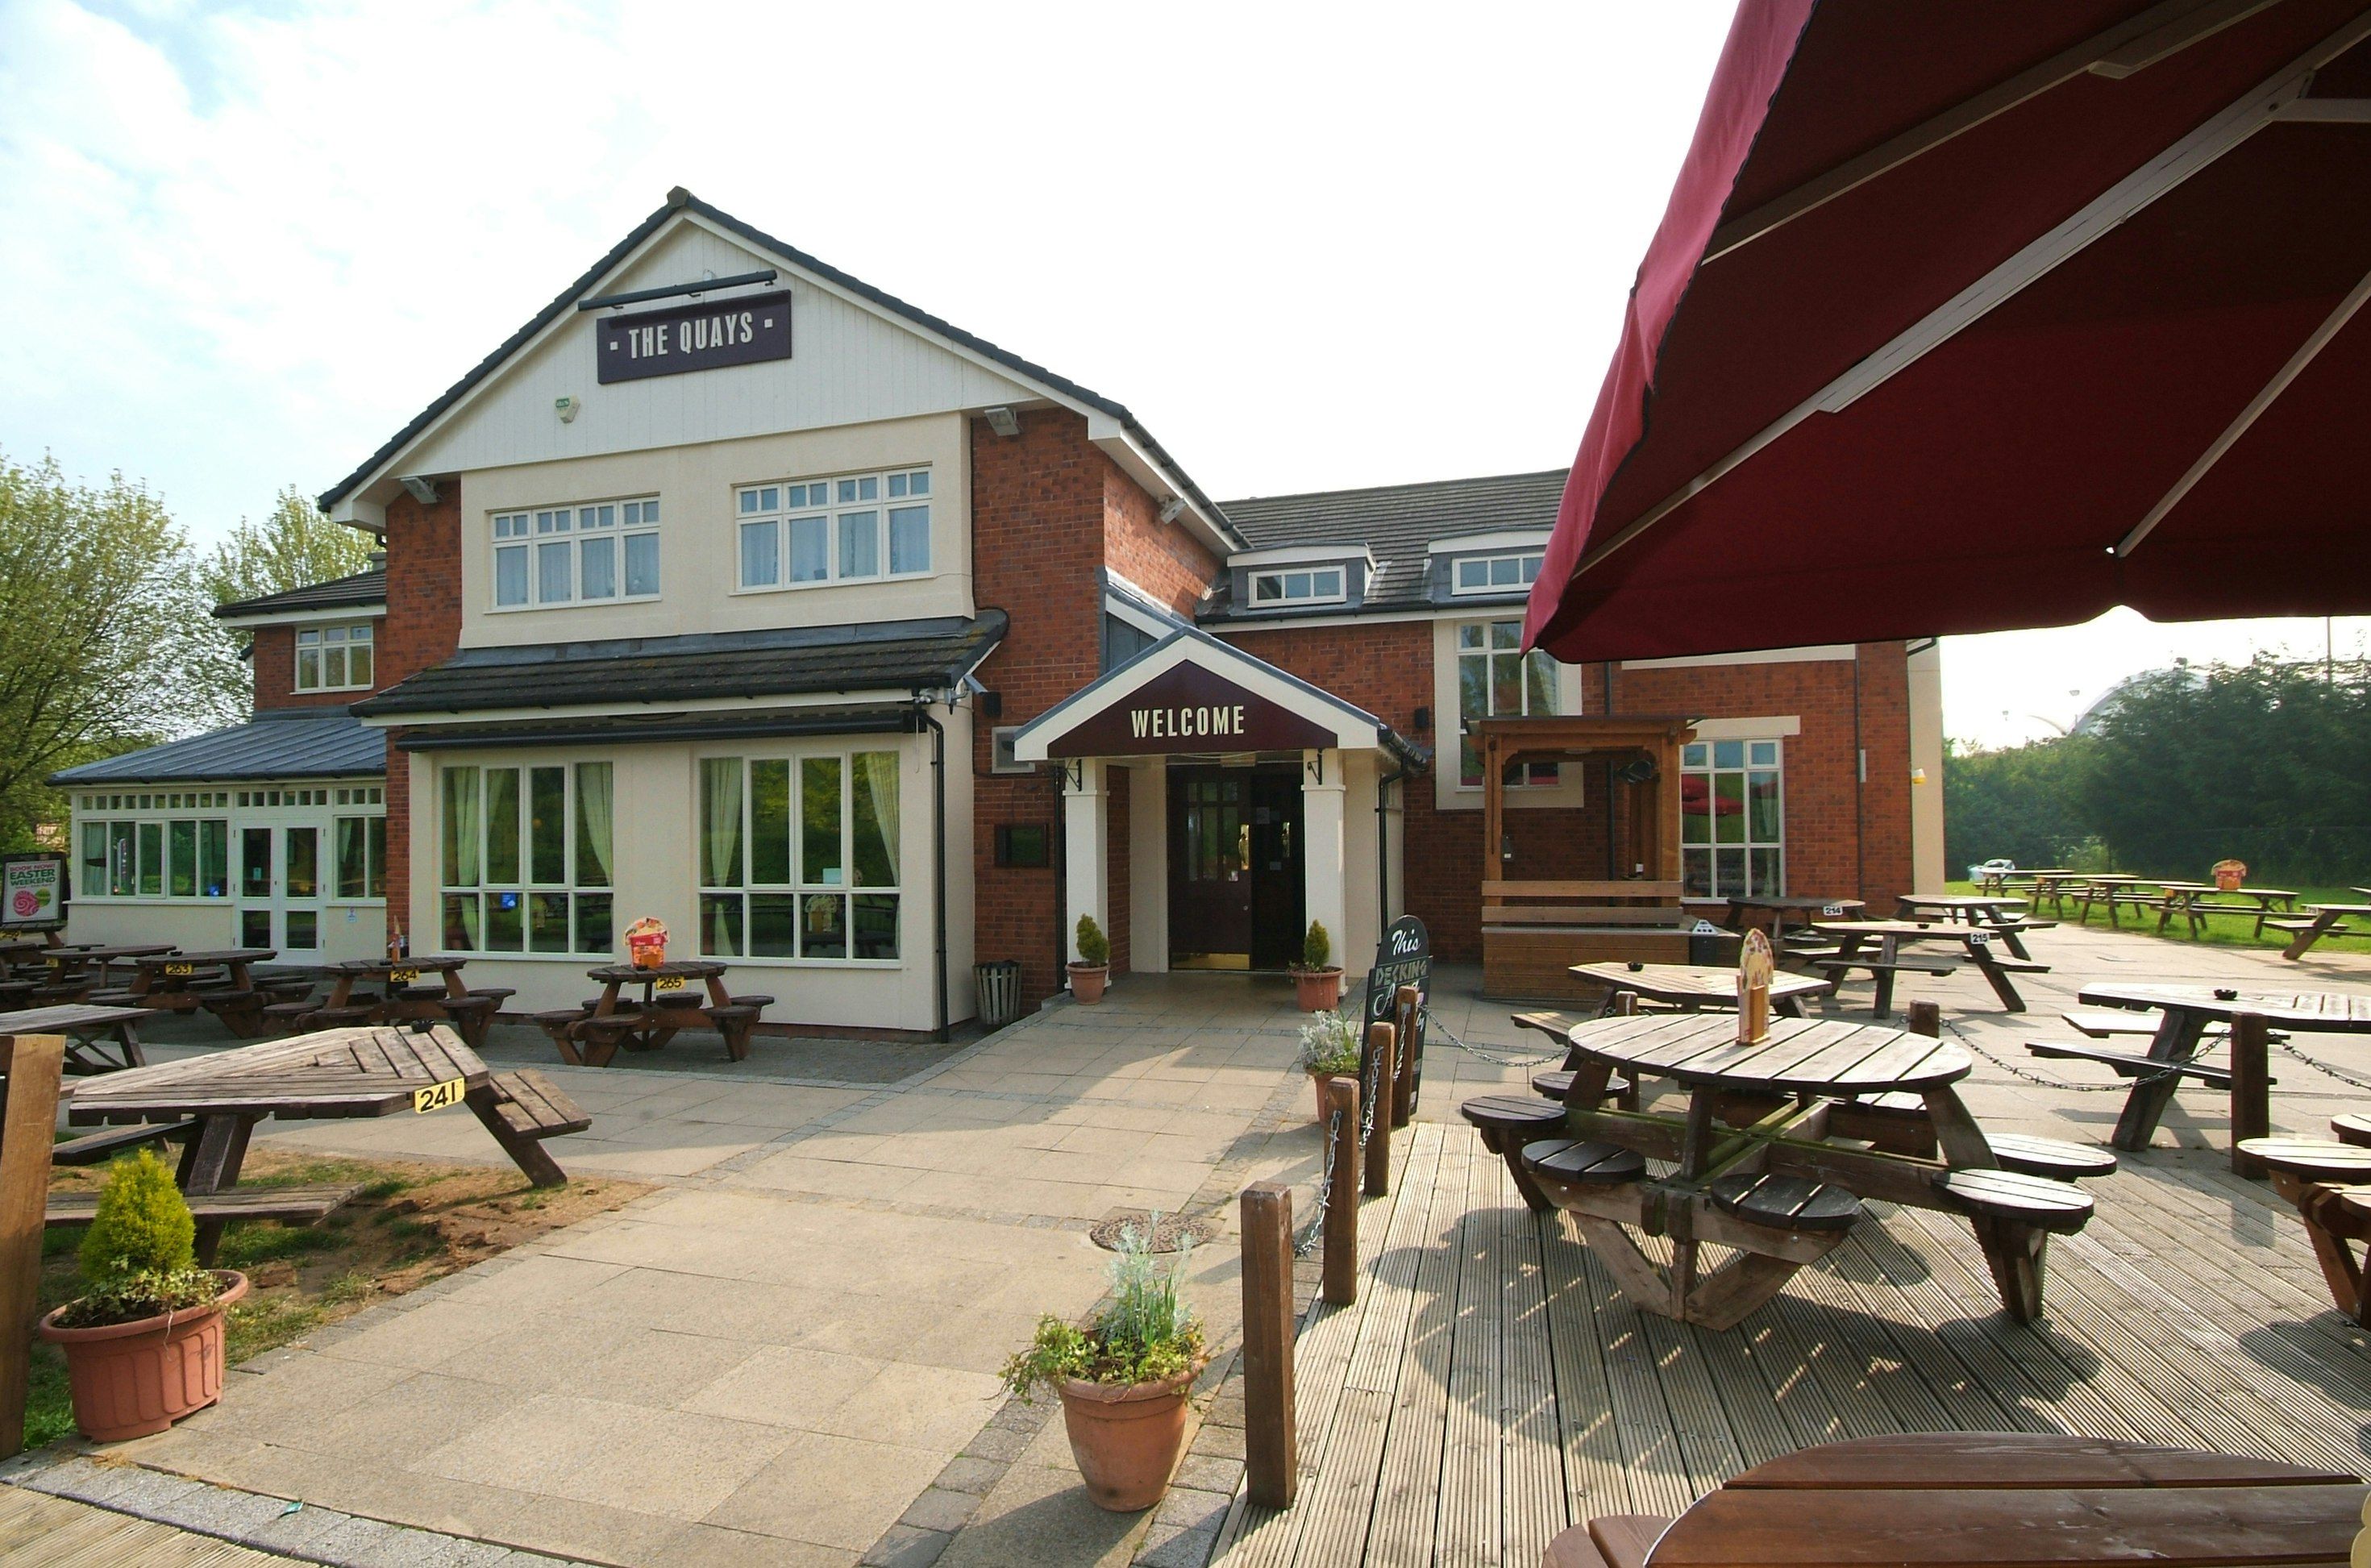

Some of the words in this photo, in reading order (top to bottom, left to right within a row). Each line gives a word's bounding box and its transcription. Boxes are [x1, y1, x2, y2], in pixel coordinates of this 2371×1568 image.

[629, 325, 668, 359] THE
[680, 312, 753, 354] QUAYS
[1131, 705, 1244, 738] WELCOME
[10, 869, 55, 880] EASTER
[10, 876, 56, 886] WEEKEND
[1392, 929, 1421, 955] This
[1973, 934, 1987, 942] 215
[168, 964, 189, 974] 263
[1375, 959, 1427, 987] DECKING
[393, 970, 417, 981] 264
[659, 977, 681, 989] 265
[420, 1082, 455, 1112] 241
